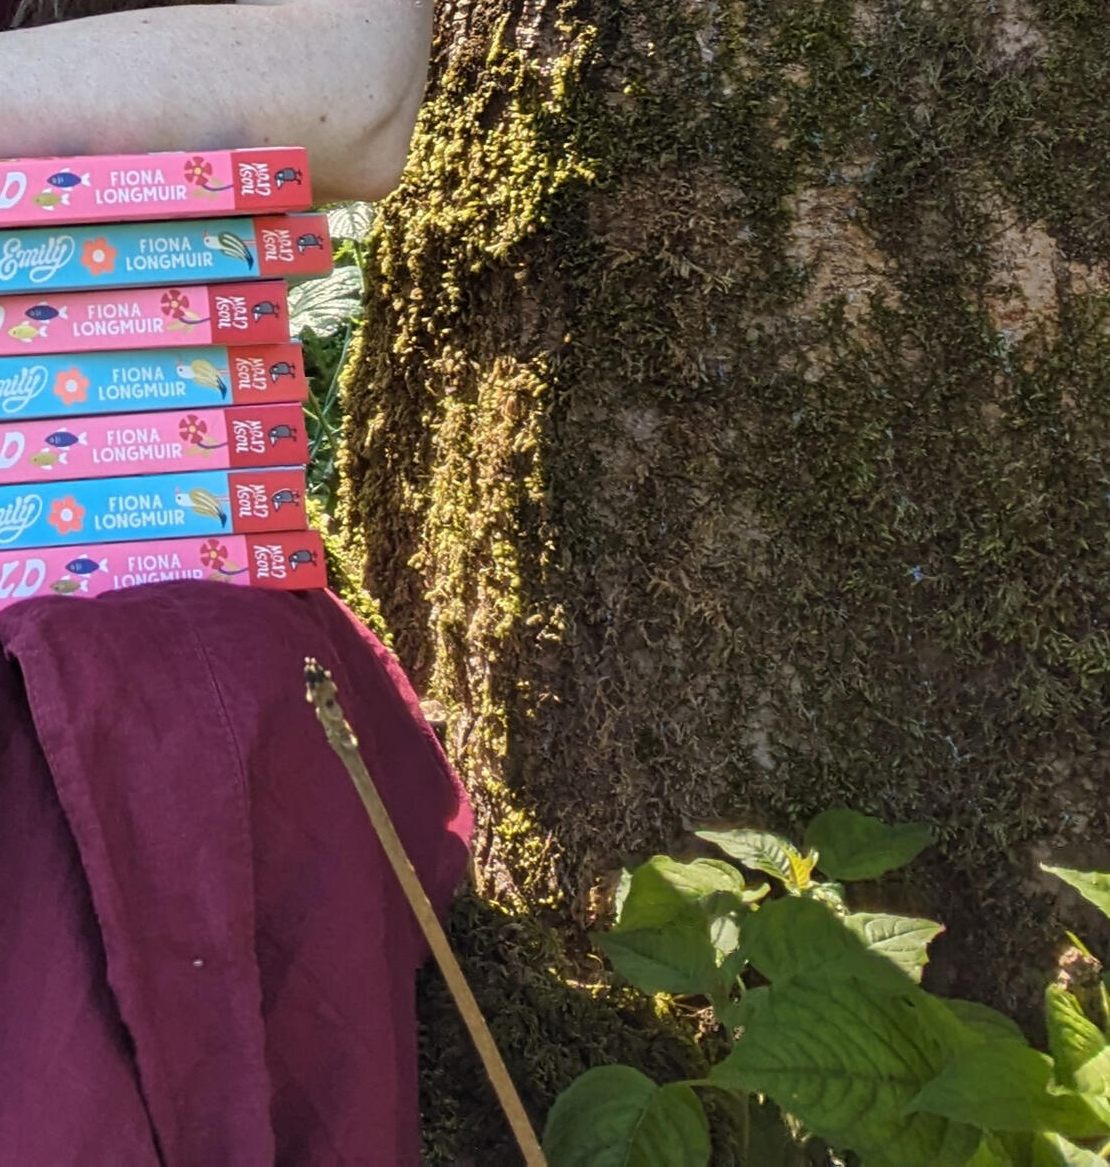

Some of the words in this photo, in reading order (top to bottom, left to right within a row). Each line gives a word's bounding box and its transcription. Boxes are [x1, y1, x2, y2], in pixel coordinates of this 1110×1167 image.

[110, 170, 165, 185] FIONA
[238, 163, 254, 196] nosy
[95, 185, 187, 205] LONGMUIR
[140, 236, 191, 252] FIONA
[262, 229, 278, 261] nosy
[126, 252, 212, 271] LONGMUIR
[88, 303, 140, 318] FIONA
[217, 296, 231, 329] nosy
[73, 318, 163, 337] LONGMUIR
[112, 367, 164, 383] FIONA
[235, 357, 250, 389] nosy
[98, 382, 186, 400] LONGMUIR
[107, 429, 160, 445] FIONA
[232, 421, 248, 453] nosy
[92, 444, 182, 463] LONGMUIR
[109, 495, 162, 510] FIONA
[236, 485, 250, 517] nosy
[95, 510, 184, 529] LONGMUIR
[128, 553, 181, 571] FIONA
[254, 545, 269, 578] nosy
